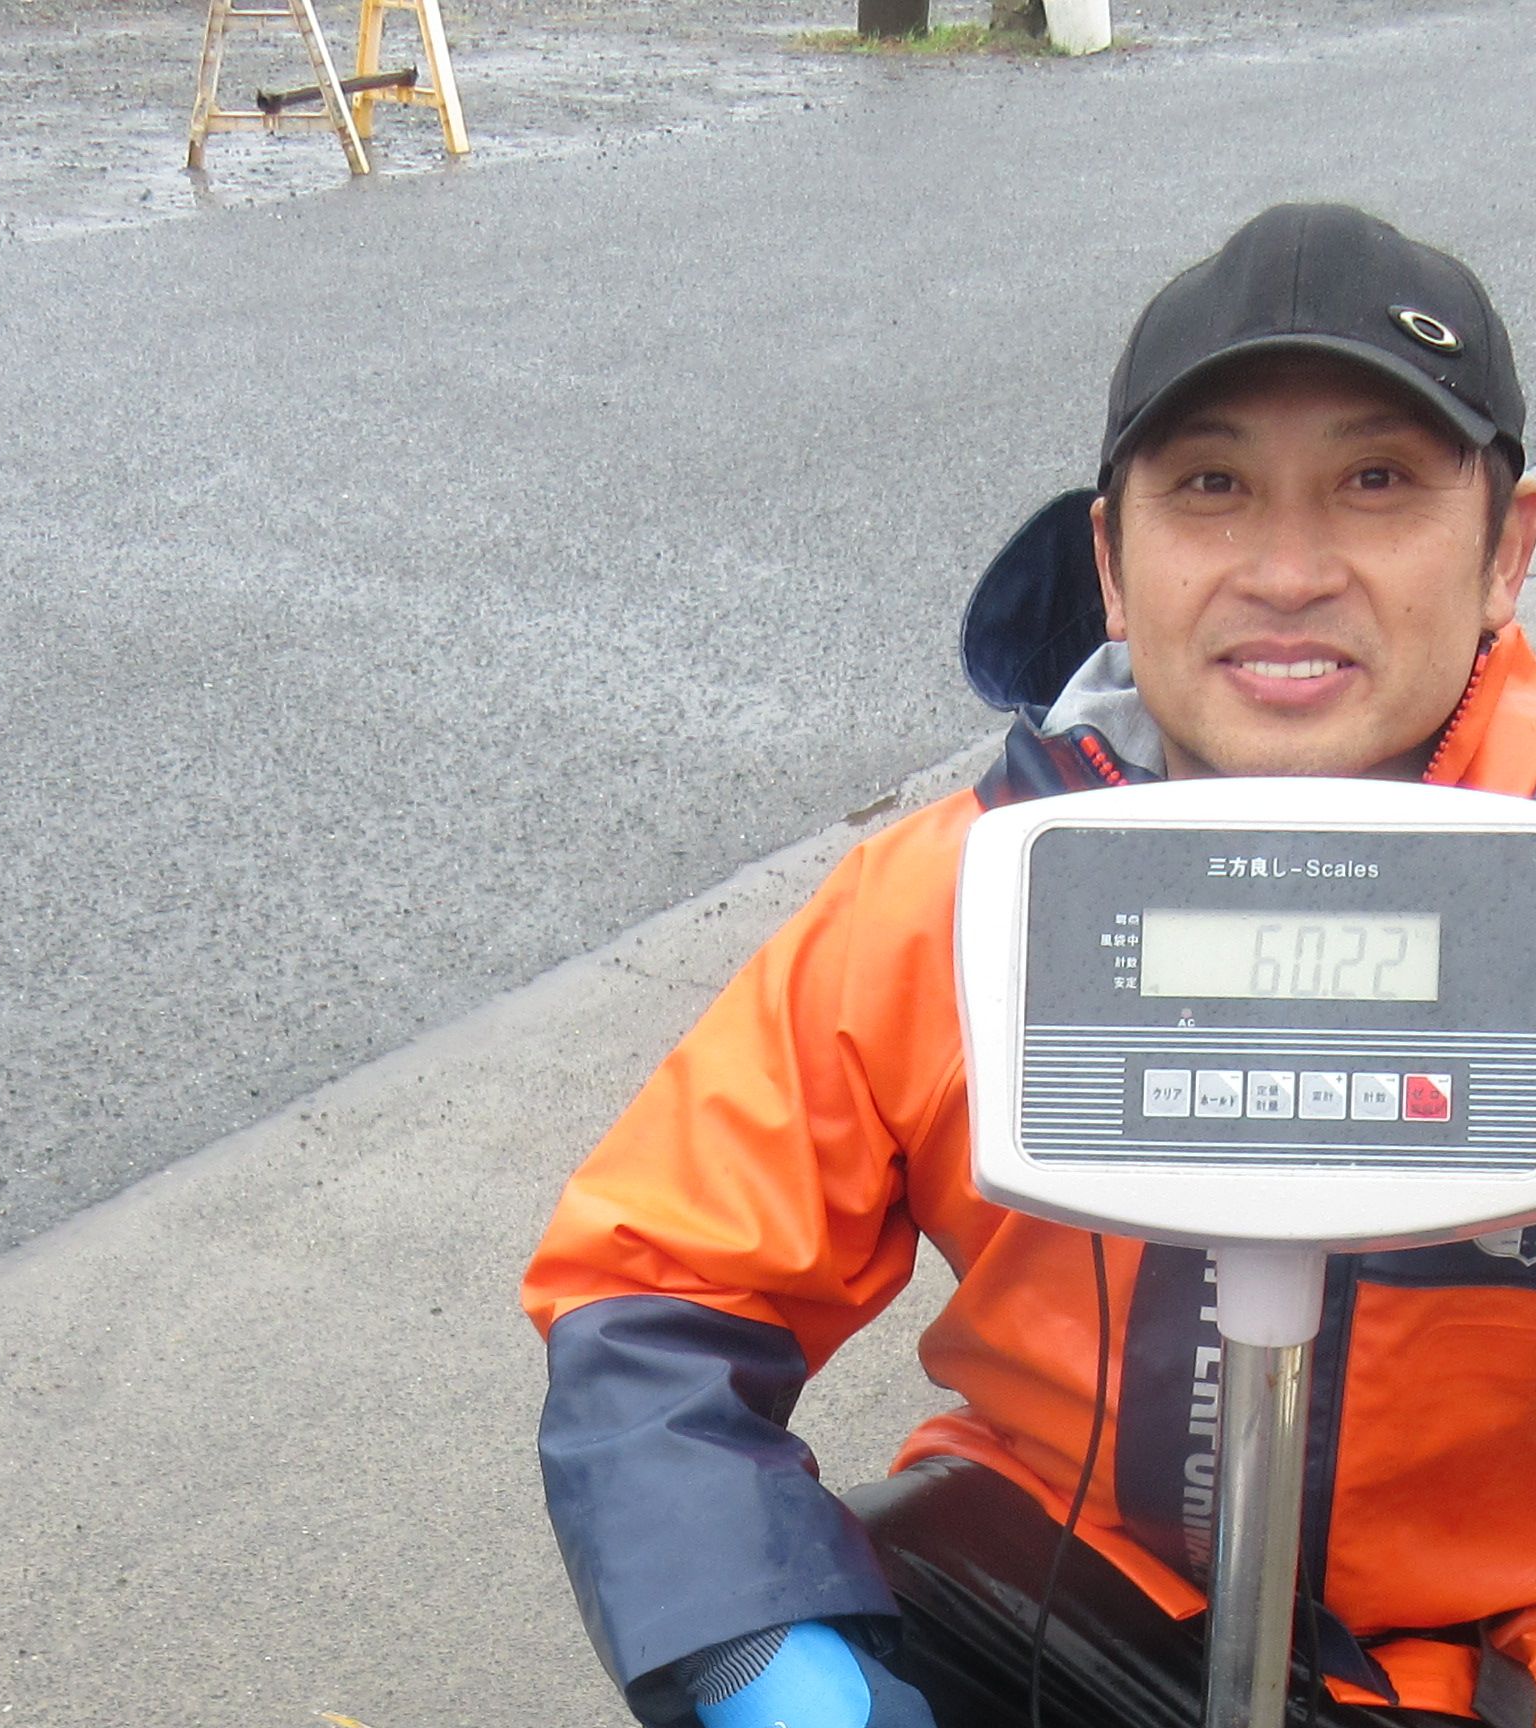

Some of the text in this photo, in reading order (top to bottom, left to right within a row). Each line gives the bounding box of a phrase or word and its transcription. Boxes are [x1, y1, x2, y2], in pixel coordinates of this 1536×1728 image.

[1114, 976, 1138, 990] 安定
[1177, 1018, 1196, 1028] AC
[1152, 1087, 1183, 1101] クリア
[1200, 1094, 1236, 1107] ホールド
